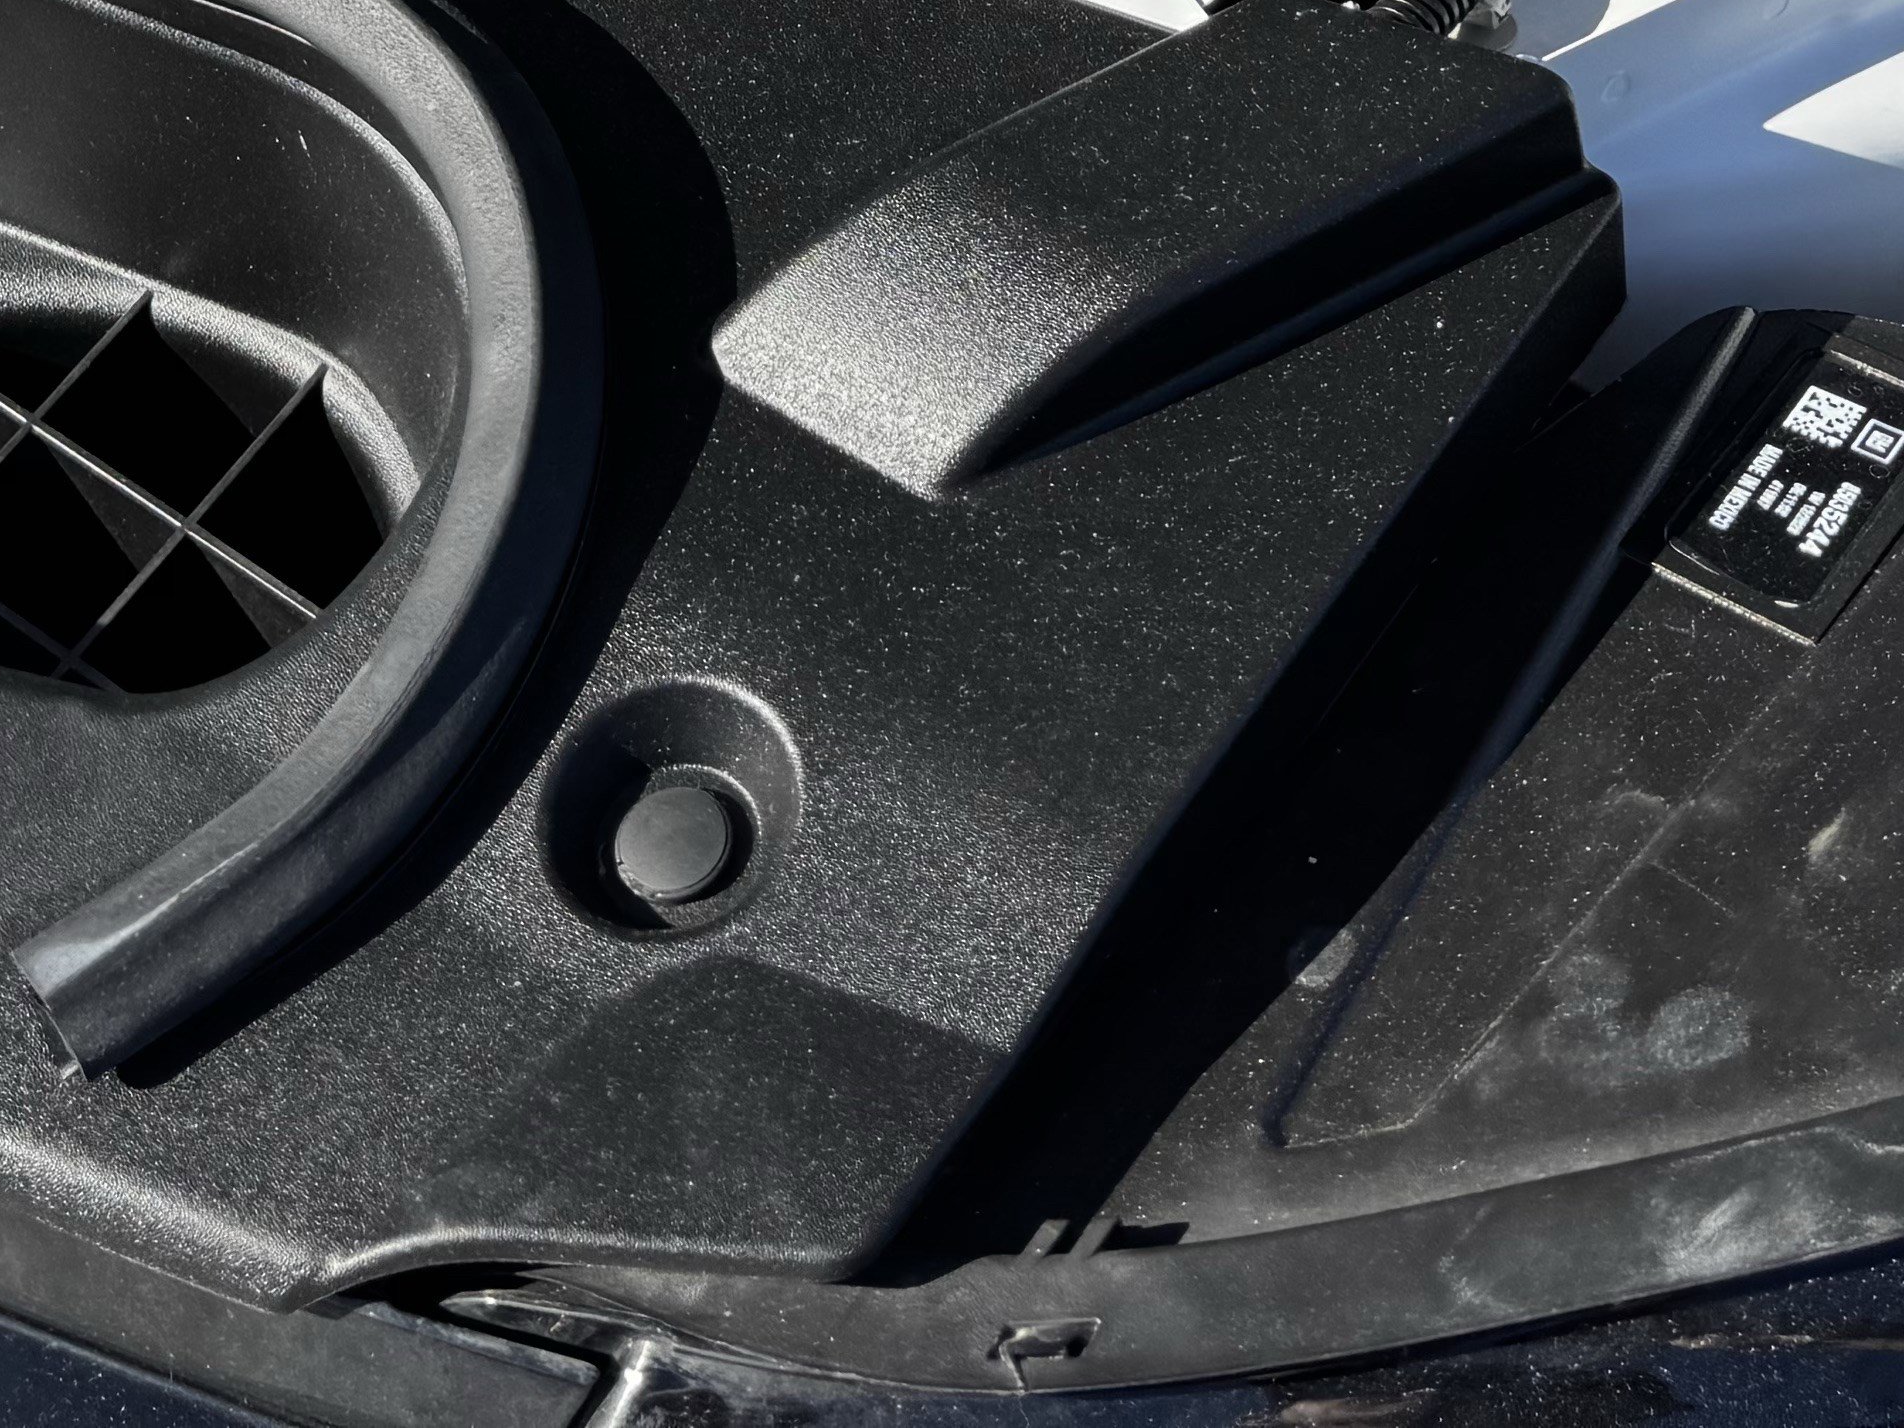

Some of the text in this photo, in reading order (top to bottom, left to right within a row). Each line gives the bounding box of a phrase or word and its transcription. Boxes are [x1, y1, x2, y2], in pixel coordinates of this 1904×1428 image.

[1747, 443, 1784, 478] MADE
[1737, 472, 1762, 492] IN
[1709, 485, 1753, 531] MEXICO
